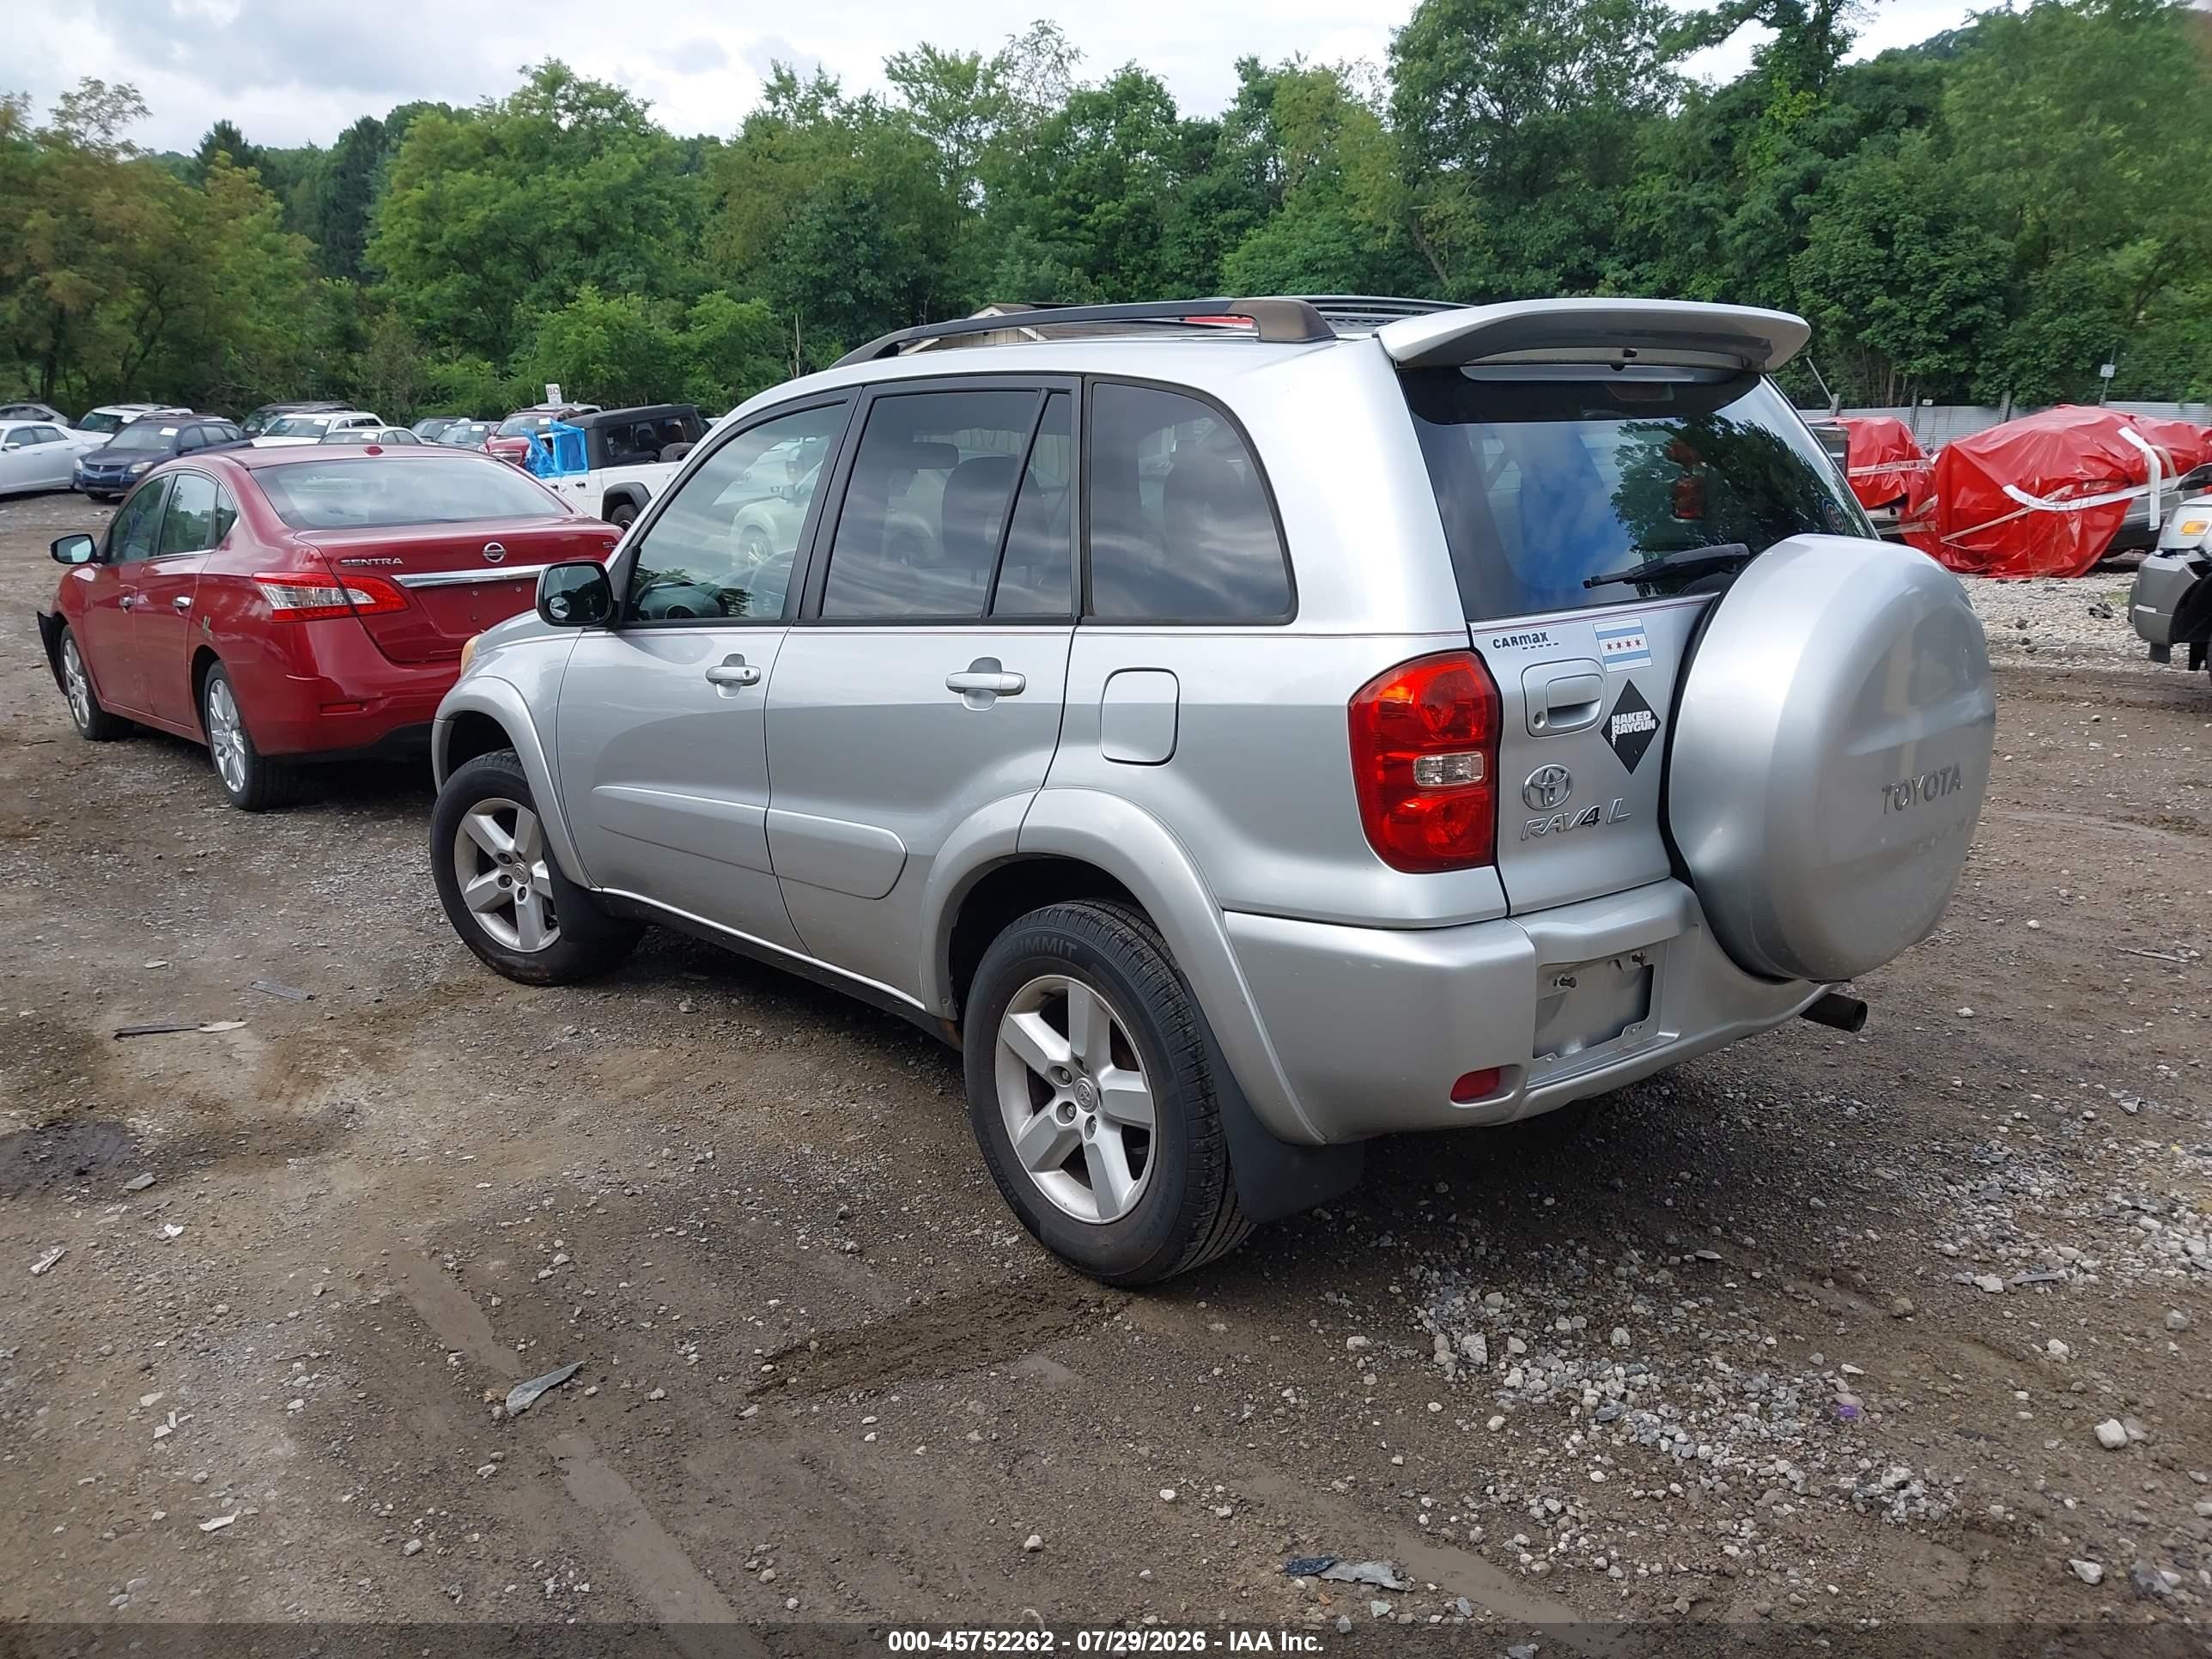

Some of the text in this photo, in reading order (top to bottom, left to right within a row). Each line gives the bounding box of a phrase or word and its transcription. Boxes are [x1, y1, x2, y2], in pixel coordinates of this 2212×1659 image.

[340, 557, 404, 567] SENTRA
[1611, 710, 1652, 726] NAKED
[1611, 719, 1656, 737] RAYGUN
[1881, 763, 1965, 815] TOYOTA
[1521, 804, 1601, 842] RAV4
